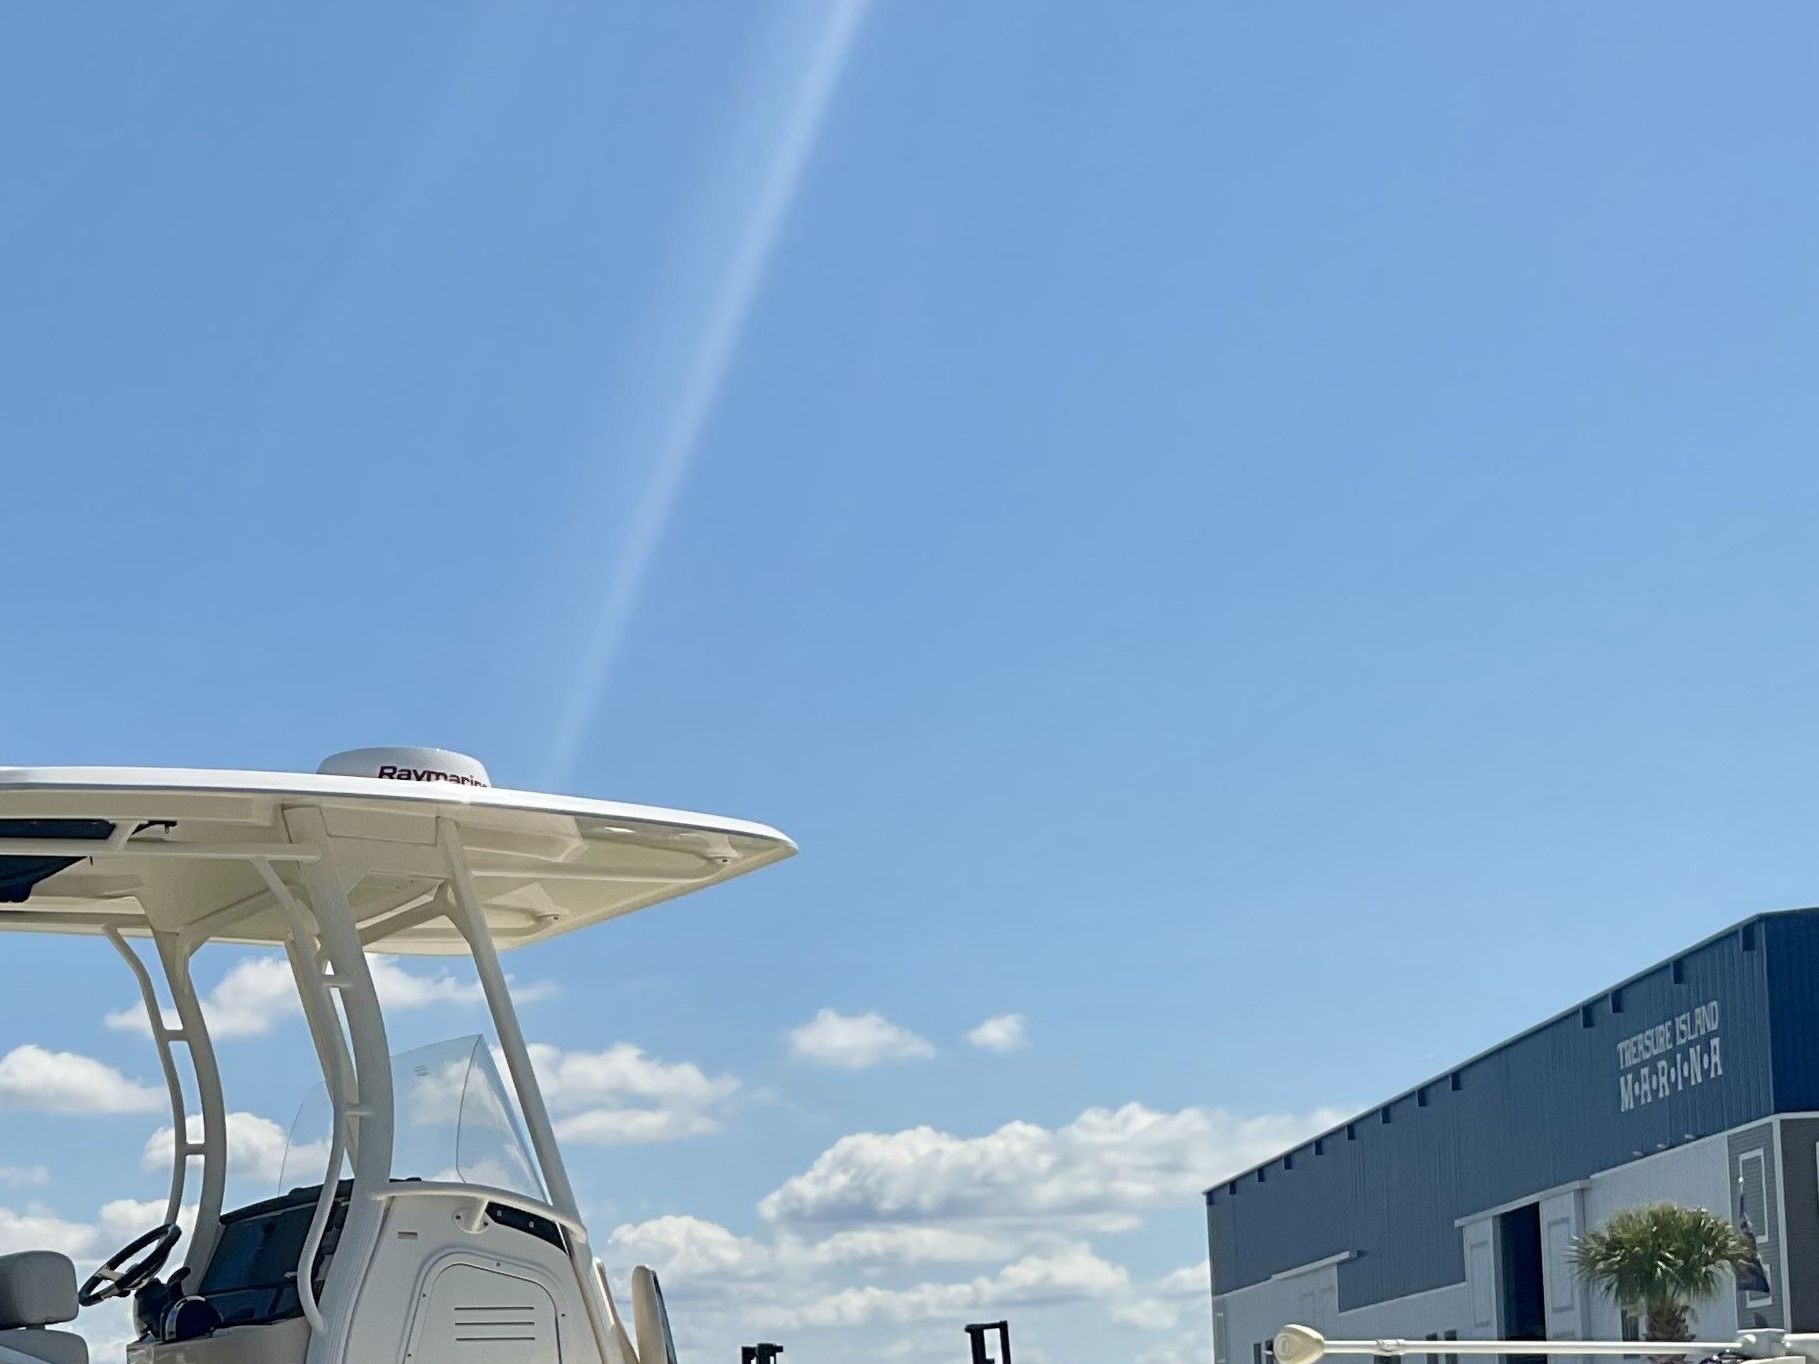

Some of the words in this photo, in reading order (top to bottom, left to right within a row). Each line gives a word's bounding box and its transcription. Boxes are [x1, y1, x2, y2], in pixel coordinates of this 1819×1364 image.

[377, 765, 488, 788] Raymarin
[1616, 1020, 1673, 1069] TREASURE
[1675, 1000, 1719, 1046] ISLAND
